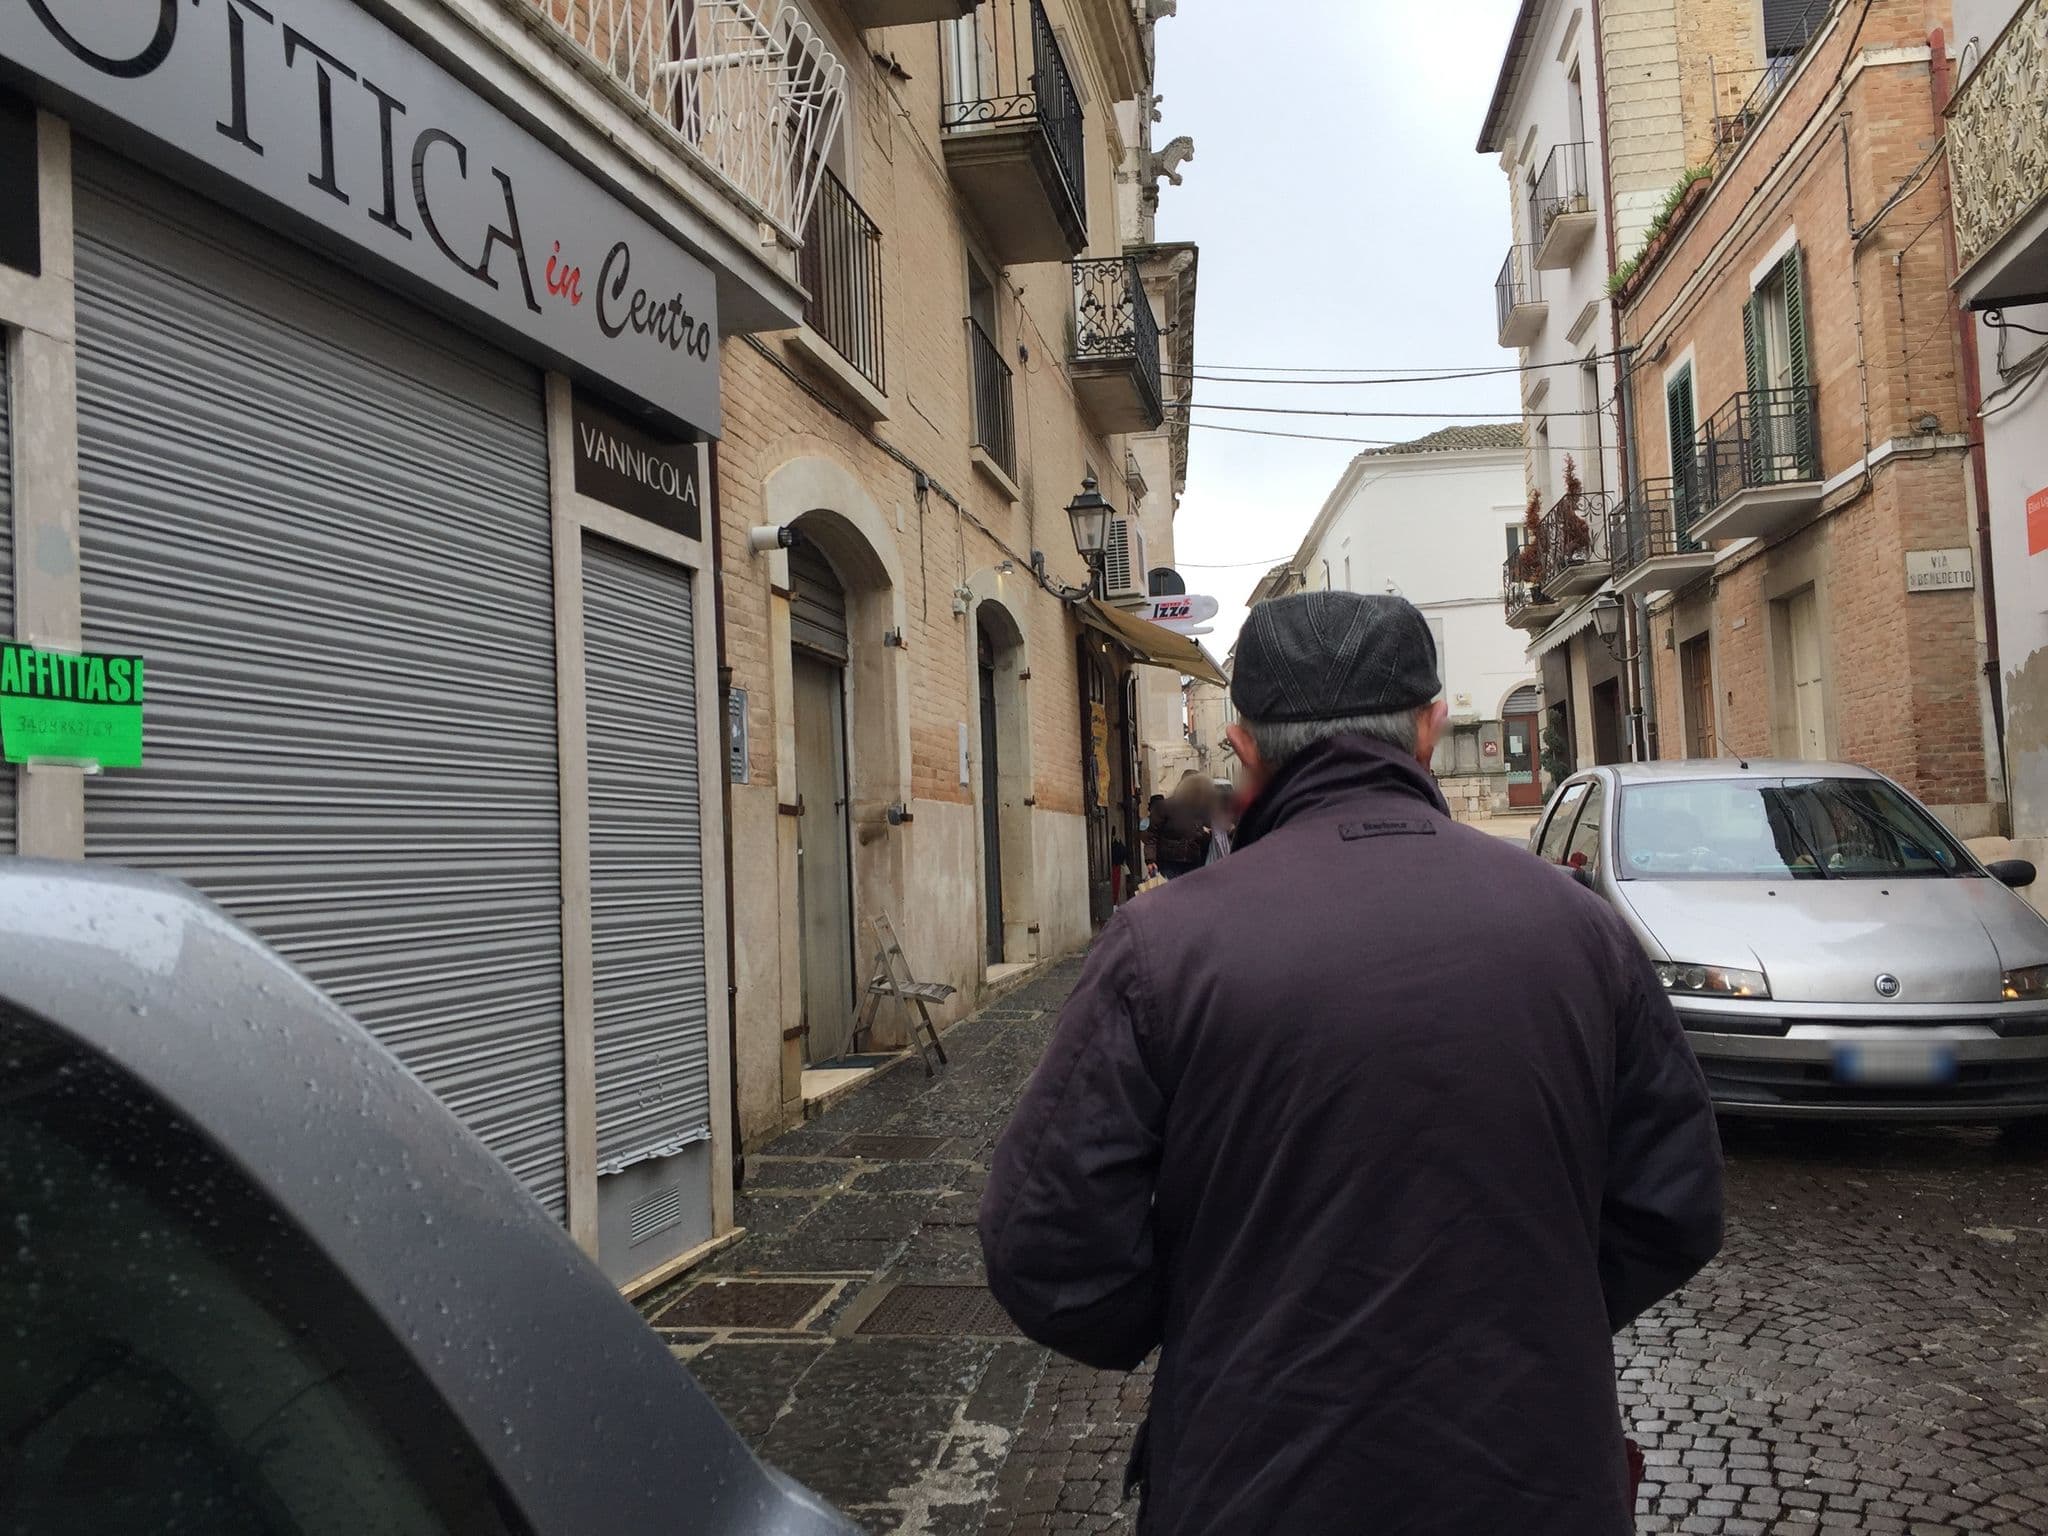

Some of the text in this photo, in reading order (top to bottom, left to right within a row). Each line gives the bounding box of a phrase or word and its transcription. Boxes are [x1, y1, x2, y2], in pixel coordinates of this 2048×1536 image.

[545, 241, 582, 305] in
[596, 242, 710, 361] Centro
[580, 422, 697, 506] VANNICOLA
[1931, 556, 1948, 568] VIA
[1, 647, 144, 702] AFFITTASI
